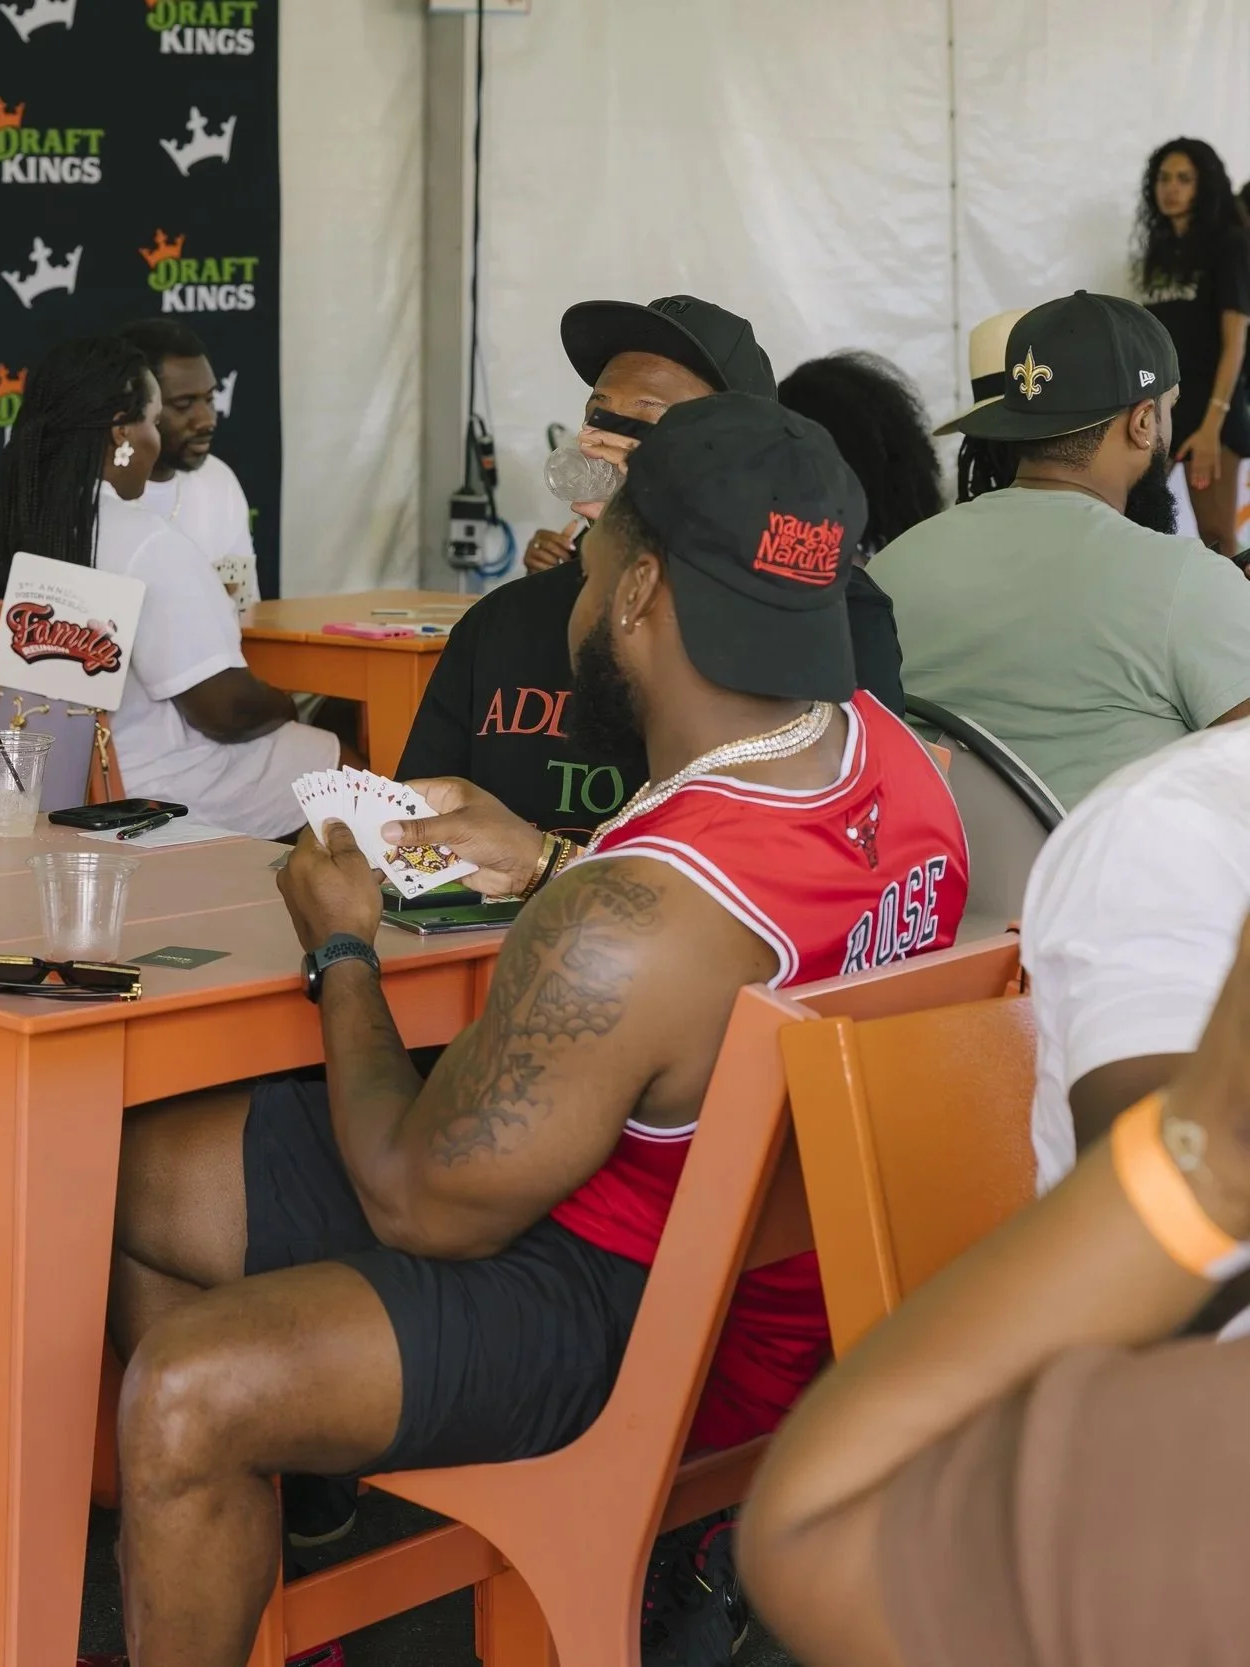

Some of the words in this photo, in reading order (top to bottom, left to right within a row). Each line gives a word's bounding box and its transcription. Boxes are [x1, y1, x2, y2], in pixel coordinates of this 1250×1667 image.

[146, 0, 259, 32] DRAFT
[159, 24, 255, 55] KINGS
[1, 154, 102, 184] KINGS
[147, 256, 259, 292] DRAFT
[161, 283, 256, 313] KINGS
[6, 602, 122, 676] Family
[547, 760, 625, 814] TO
[839, 855, 948, 976] ROSE
